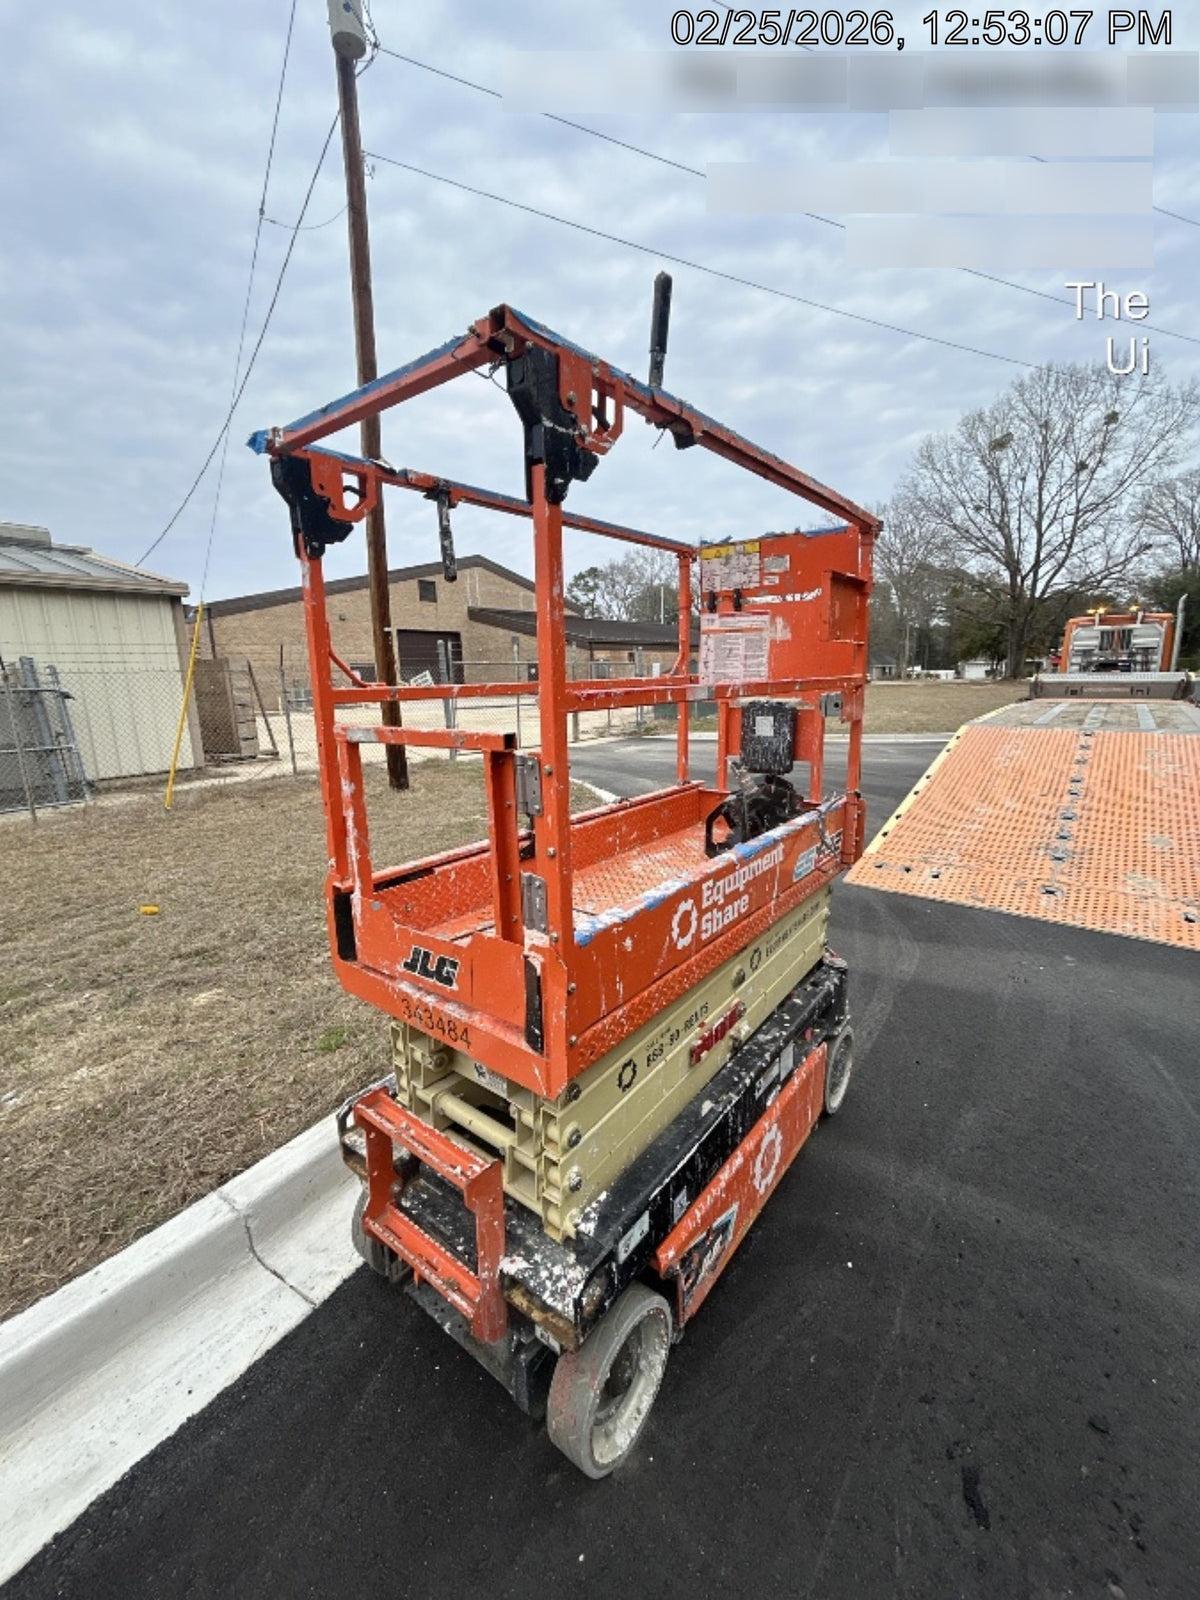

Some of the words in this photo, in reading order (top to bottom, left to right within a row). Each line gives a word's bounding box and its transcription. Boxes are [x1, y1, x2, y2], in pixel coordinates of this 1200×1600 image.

[702, 842, 784, 910] Equipment
[701, 894, 750, 941] Share
[402, 945, 460, 990] JLG
[401, 998, 471, 1050] 343484
